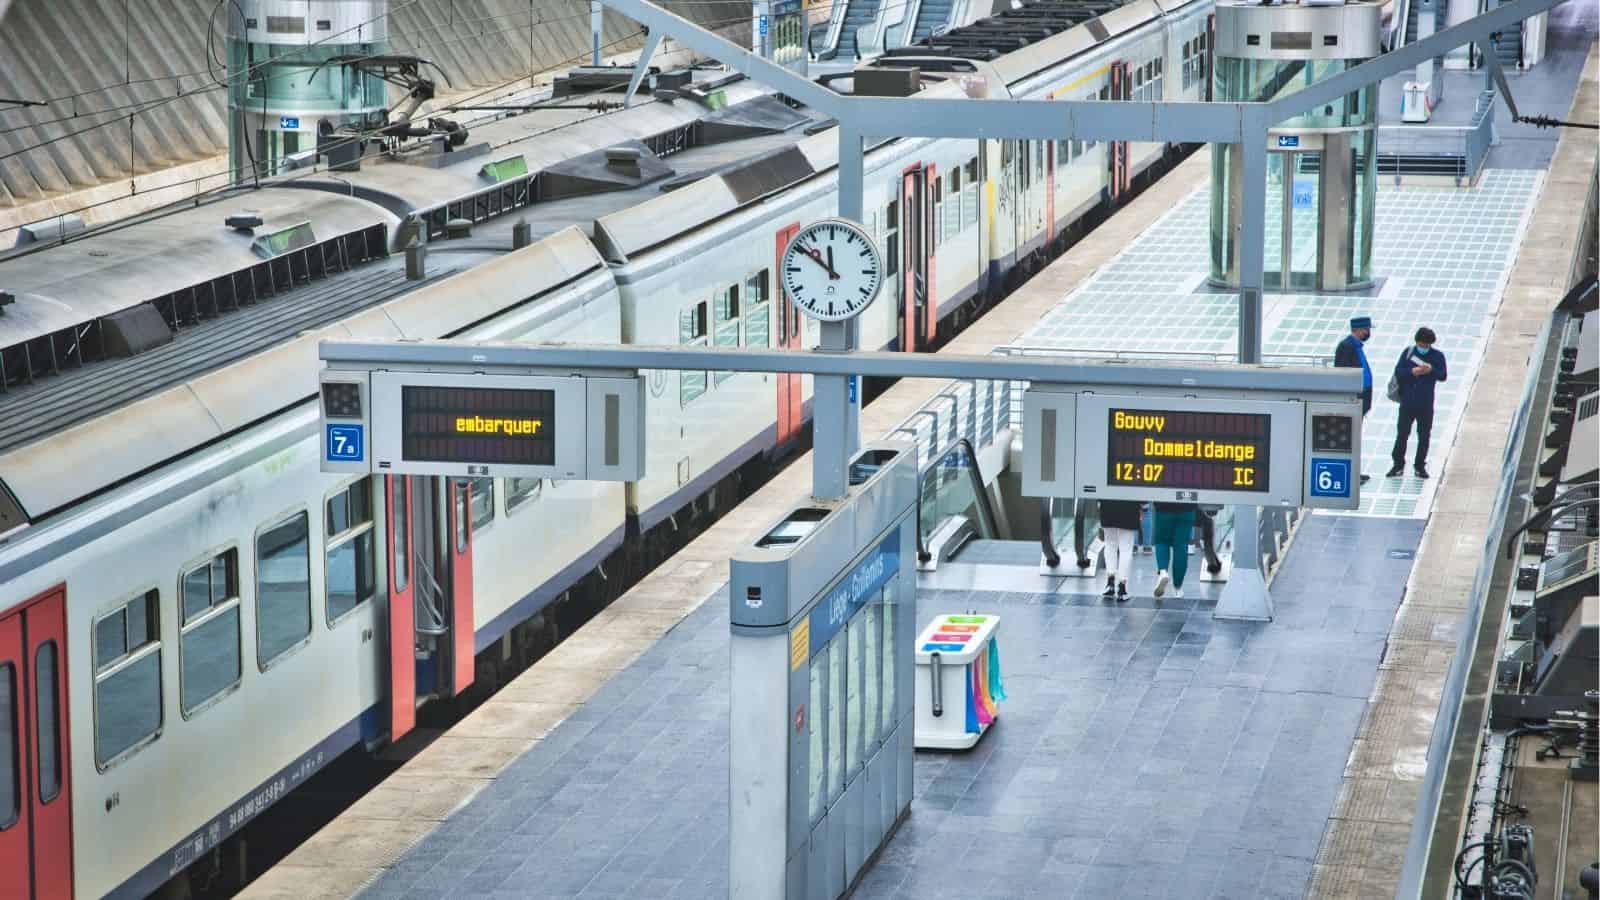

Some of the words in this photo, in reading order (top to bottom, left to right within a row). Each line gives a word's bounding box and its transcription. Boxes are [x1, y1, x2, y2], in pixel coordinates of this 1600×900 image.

[456, 416, 542, 436] embarquer
[1115, 411, 1165, 432] Gouvy
[1144, 438, 1255, 462] Dommeldange
[1115, 463, 1164, 482] 12:07
[1233, 467, 1254, 486] IC
